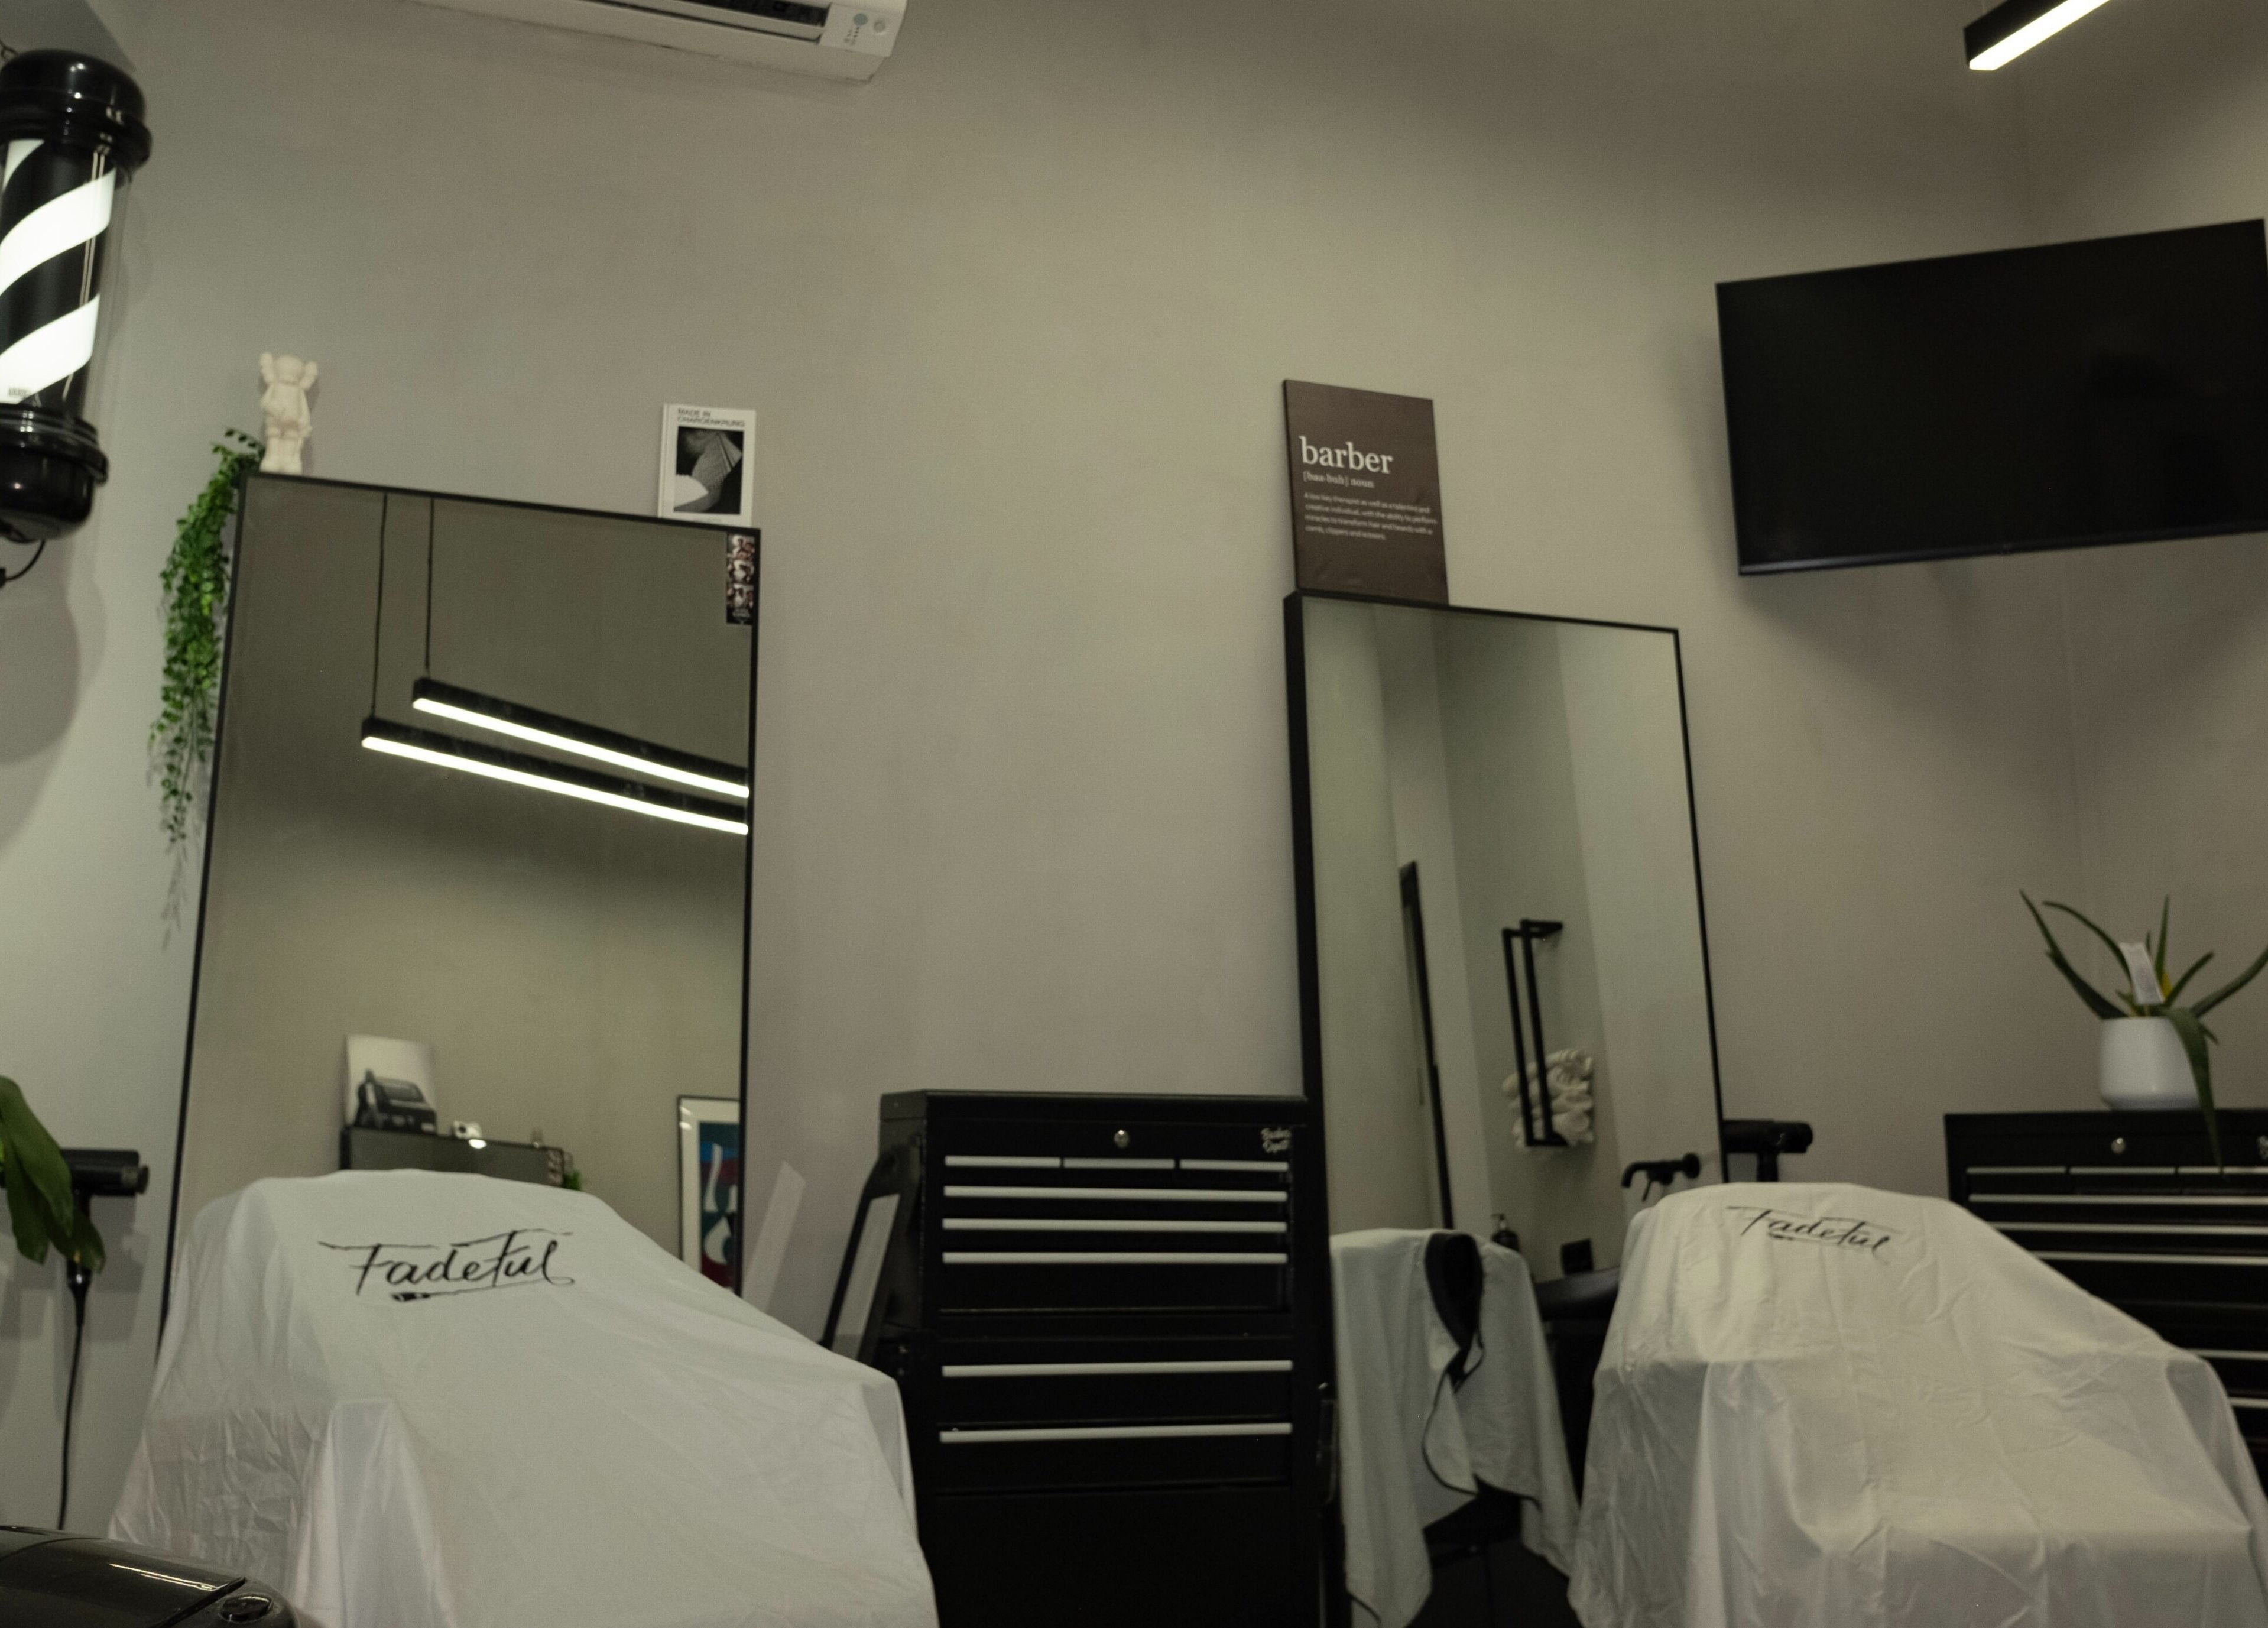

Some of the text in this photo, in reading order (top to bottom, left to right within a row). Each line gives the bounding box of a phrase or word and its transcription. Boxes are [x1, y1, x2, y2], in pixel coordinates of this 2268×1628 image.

[1299, 435, 1394, 474] barber
[1351, 479, 1374, 488] noun
[1393, 503, 1417, 512] talented
[1305, 504, 1329, 512] creative
[1386, 513, 1404, 522] ability
[1337, 518, 1367, 526] transform
